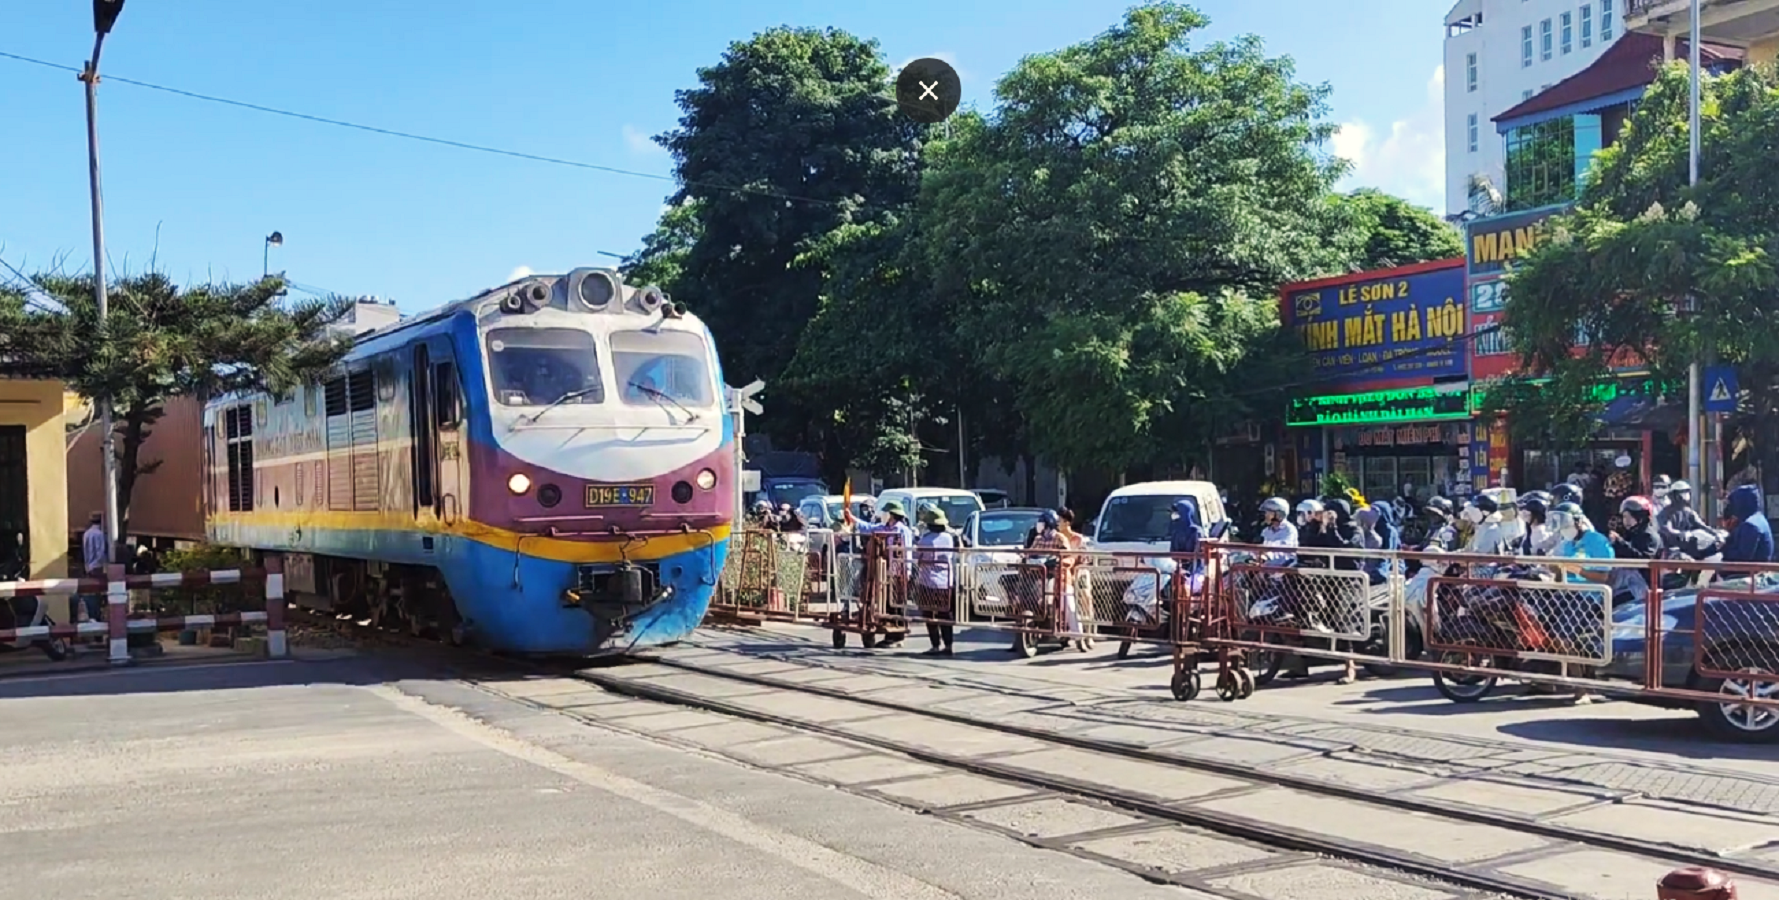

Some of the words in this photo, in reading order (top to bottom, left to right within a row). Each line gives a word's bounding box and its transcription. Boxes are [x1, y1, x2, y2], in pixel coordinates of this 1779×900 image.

[1398, 281, 1409, 298] 2
[1345, 304, 1385, 348] MẮT
[1392, 304, 1421, 342] HÀ
[1427, 298, 1464, 341] NỘI
